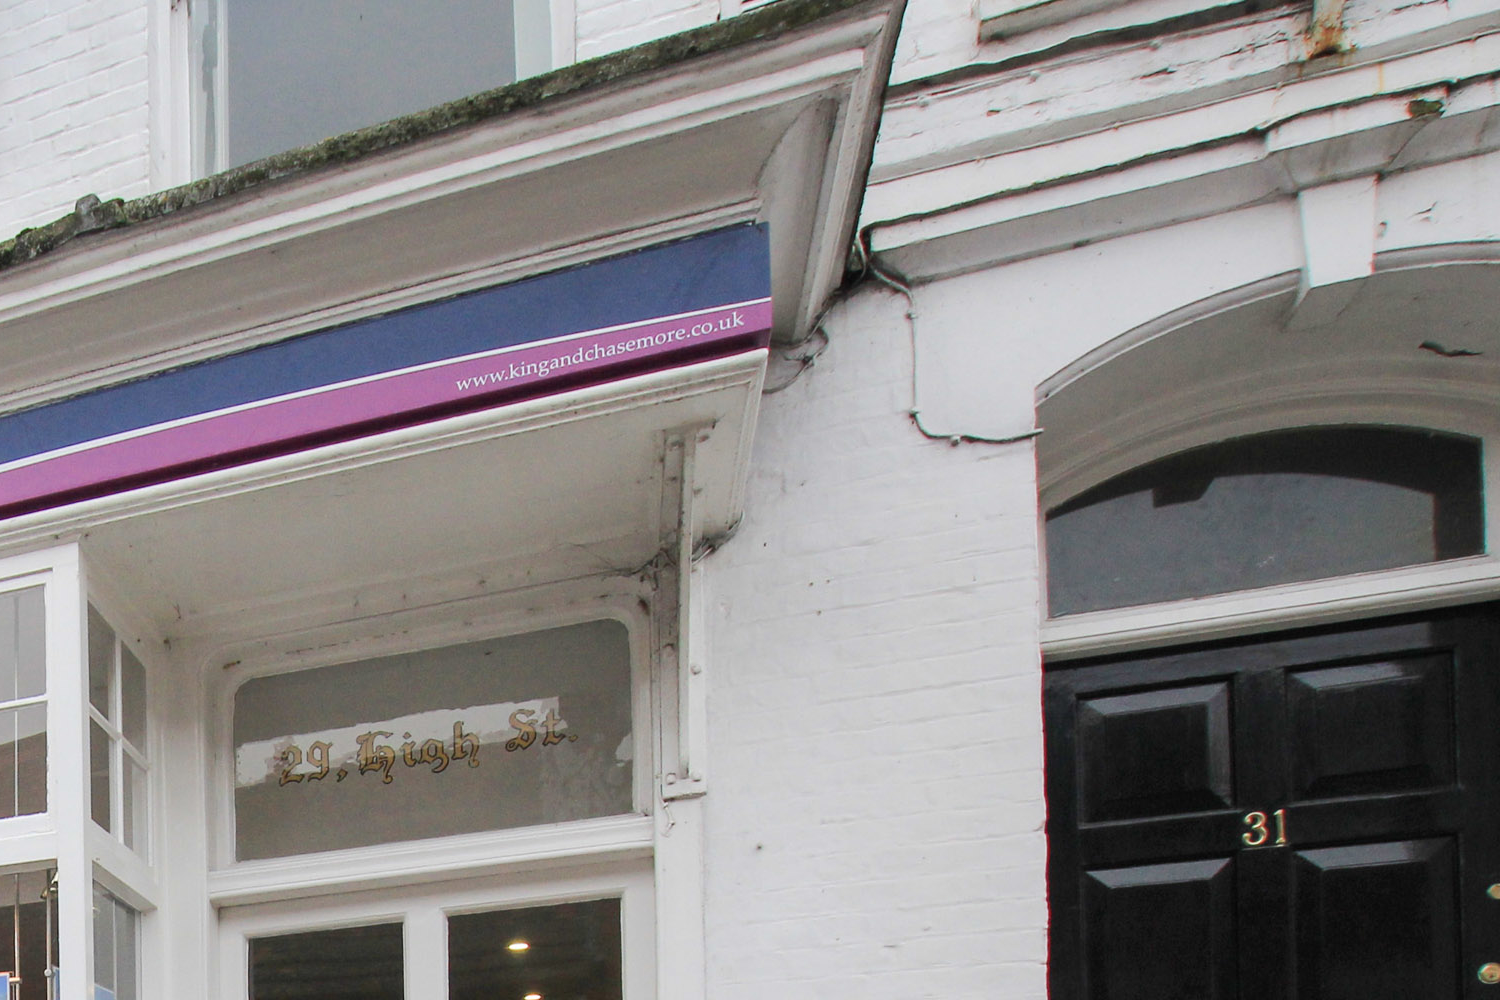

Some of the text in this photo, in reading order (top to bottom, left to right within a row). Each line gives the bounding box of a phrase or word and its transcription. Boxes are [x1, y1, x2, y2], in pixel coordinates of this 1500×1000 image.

[456, 311, 745, 392] www.kingandchasemore.co.uk
[355, 719, 482, 785] High
[1242, 809, 1286, 846] 31
